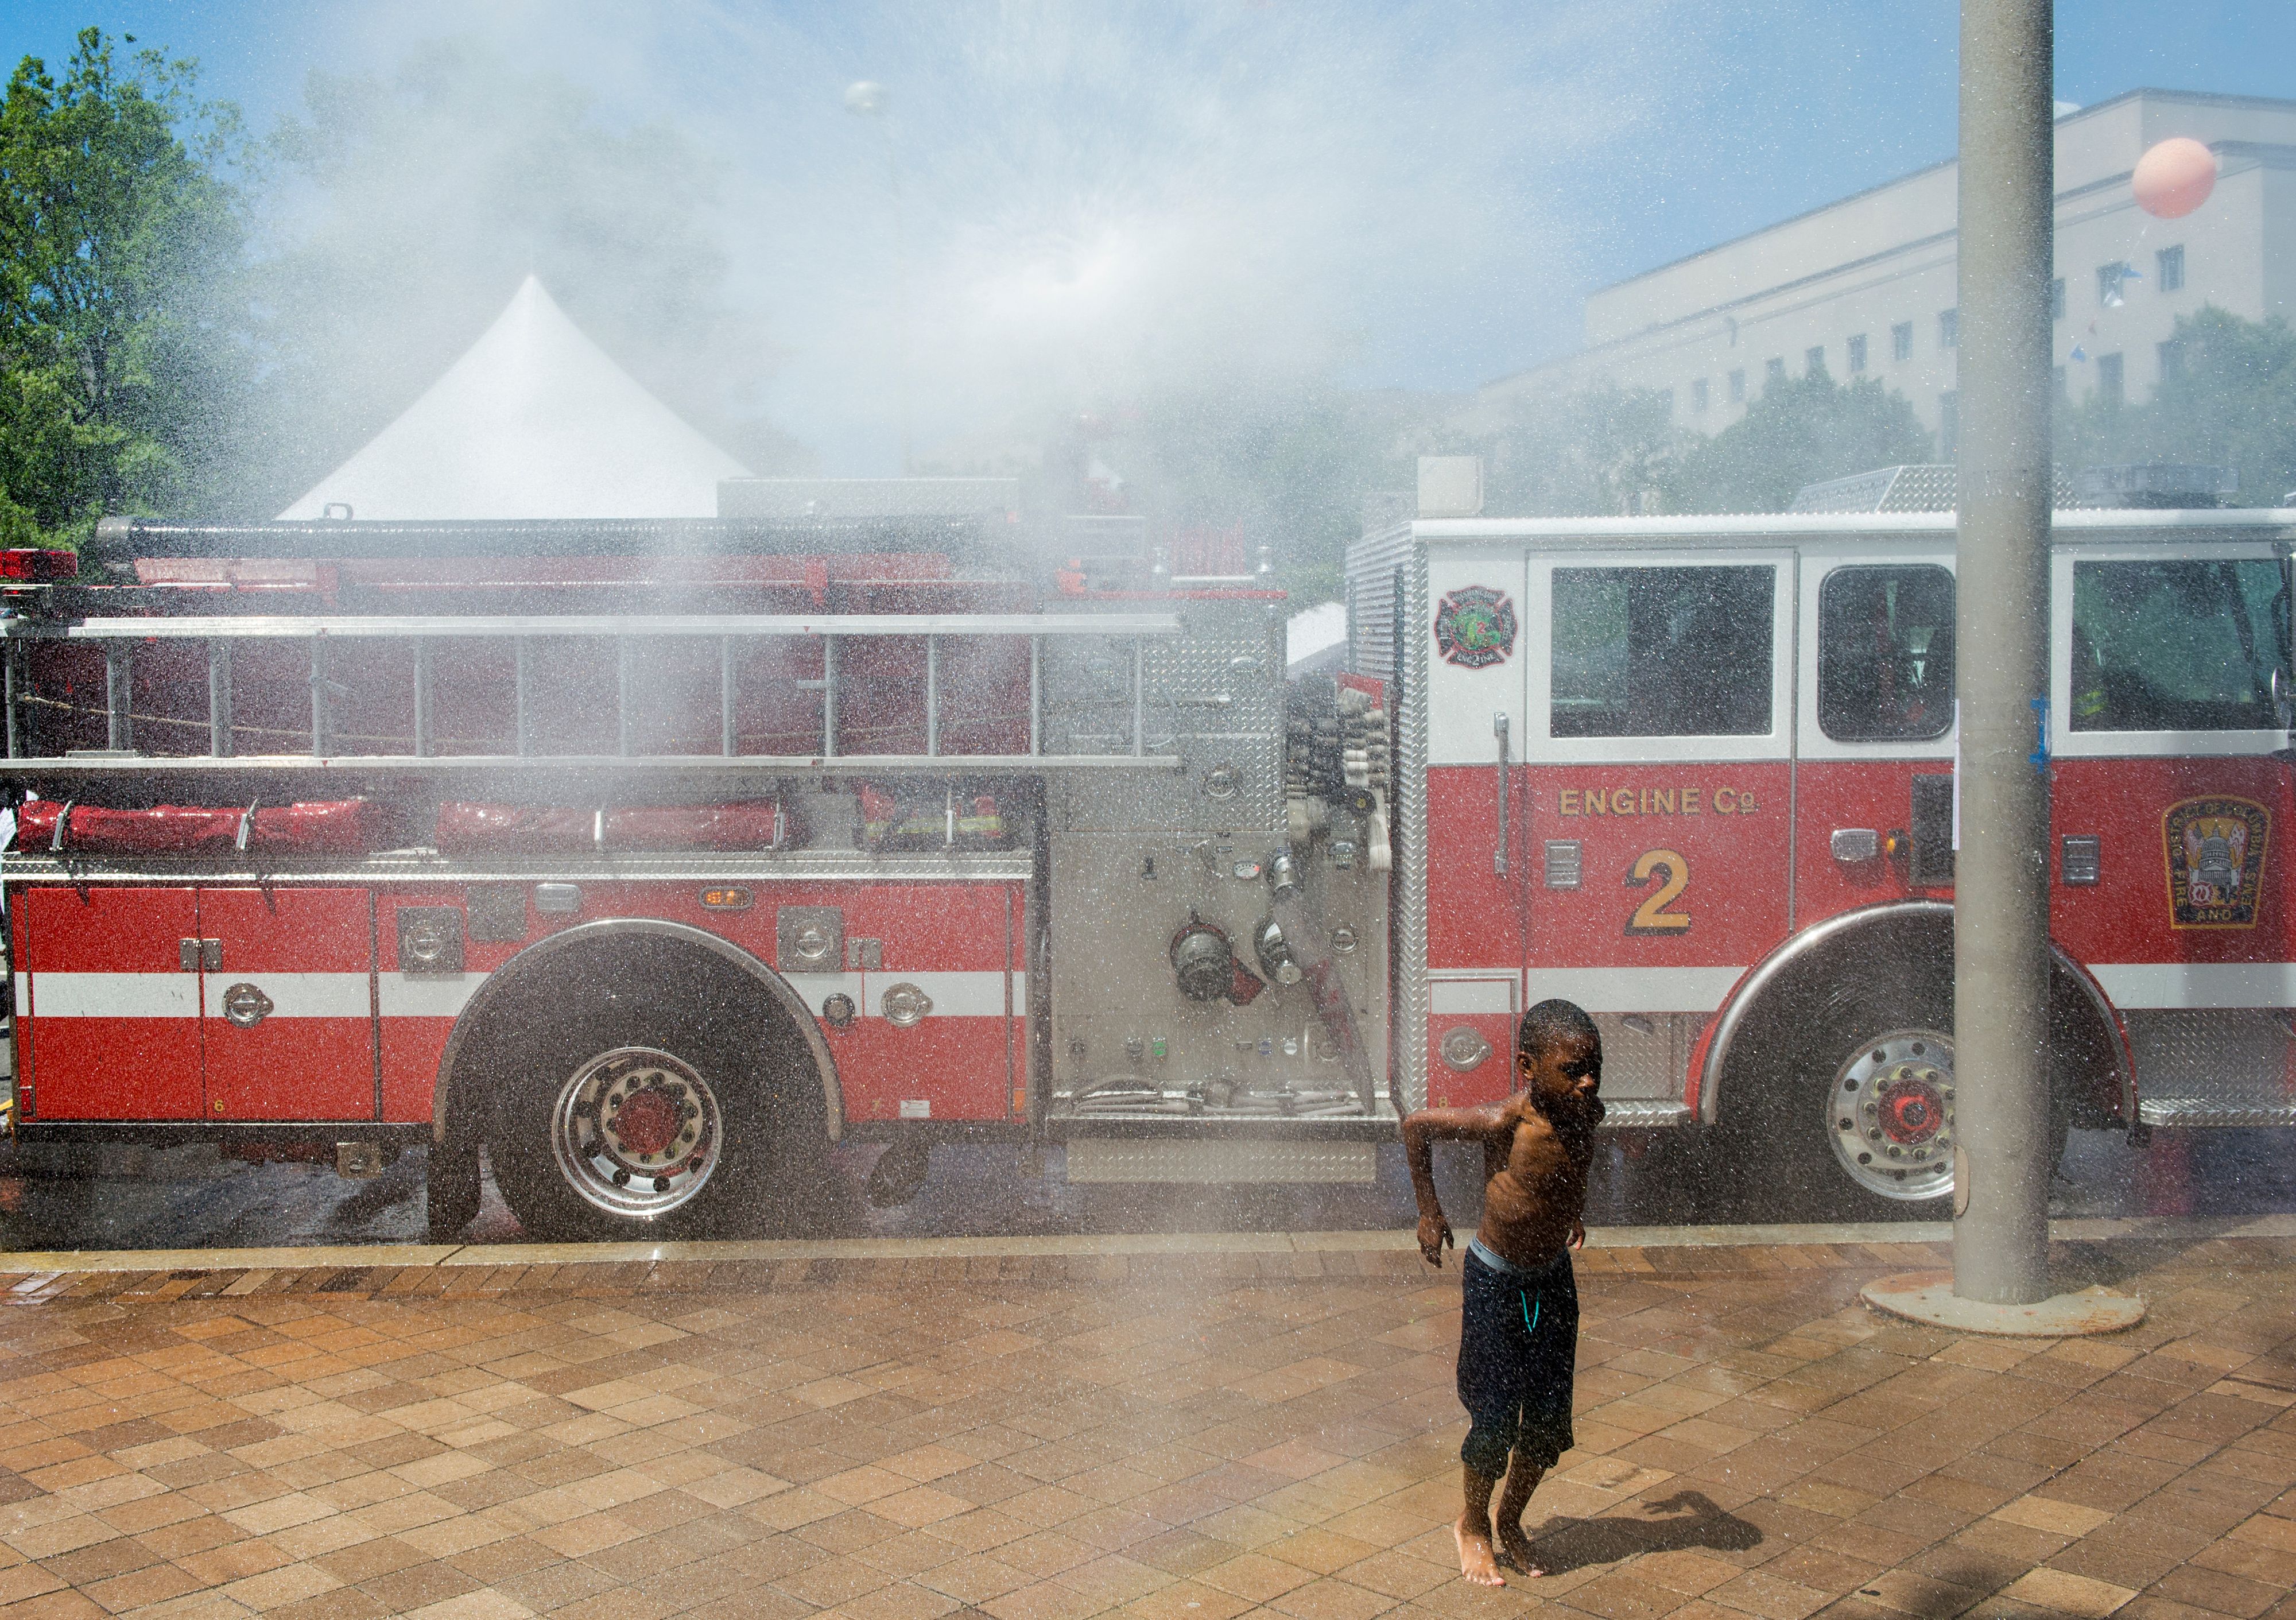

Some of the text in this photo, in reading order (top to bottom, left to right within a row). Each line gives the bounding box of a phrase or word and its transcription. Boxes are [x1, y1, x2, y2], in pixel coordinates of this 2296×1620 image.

[1476, 621, 1487, 634] 2
[1559, 788, 1701, 816] ENGINE
[2205, 804, 2220, 814] OF
[1624, 848, 1692, 936] 2
[2174, 870, 2256, 921] FIRE AND EMS
[214, 1099, 224, 1113] 6
[1438, 1096, 1448, 1108] 8
